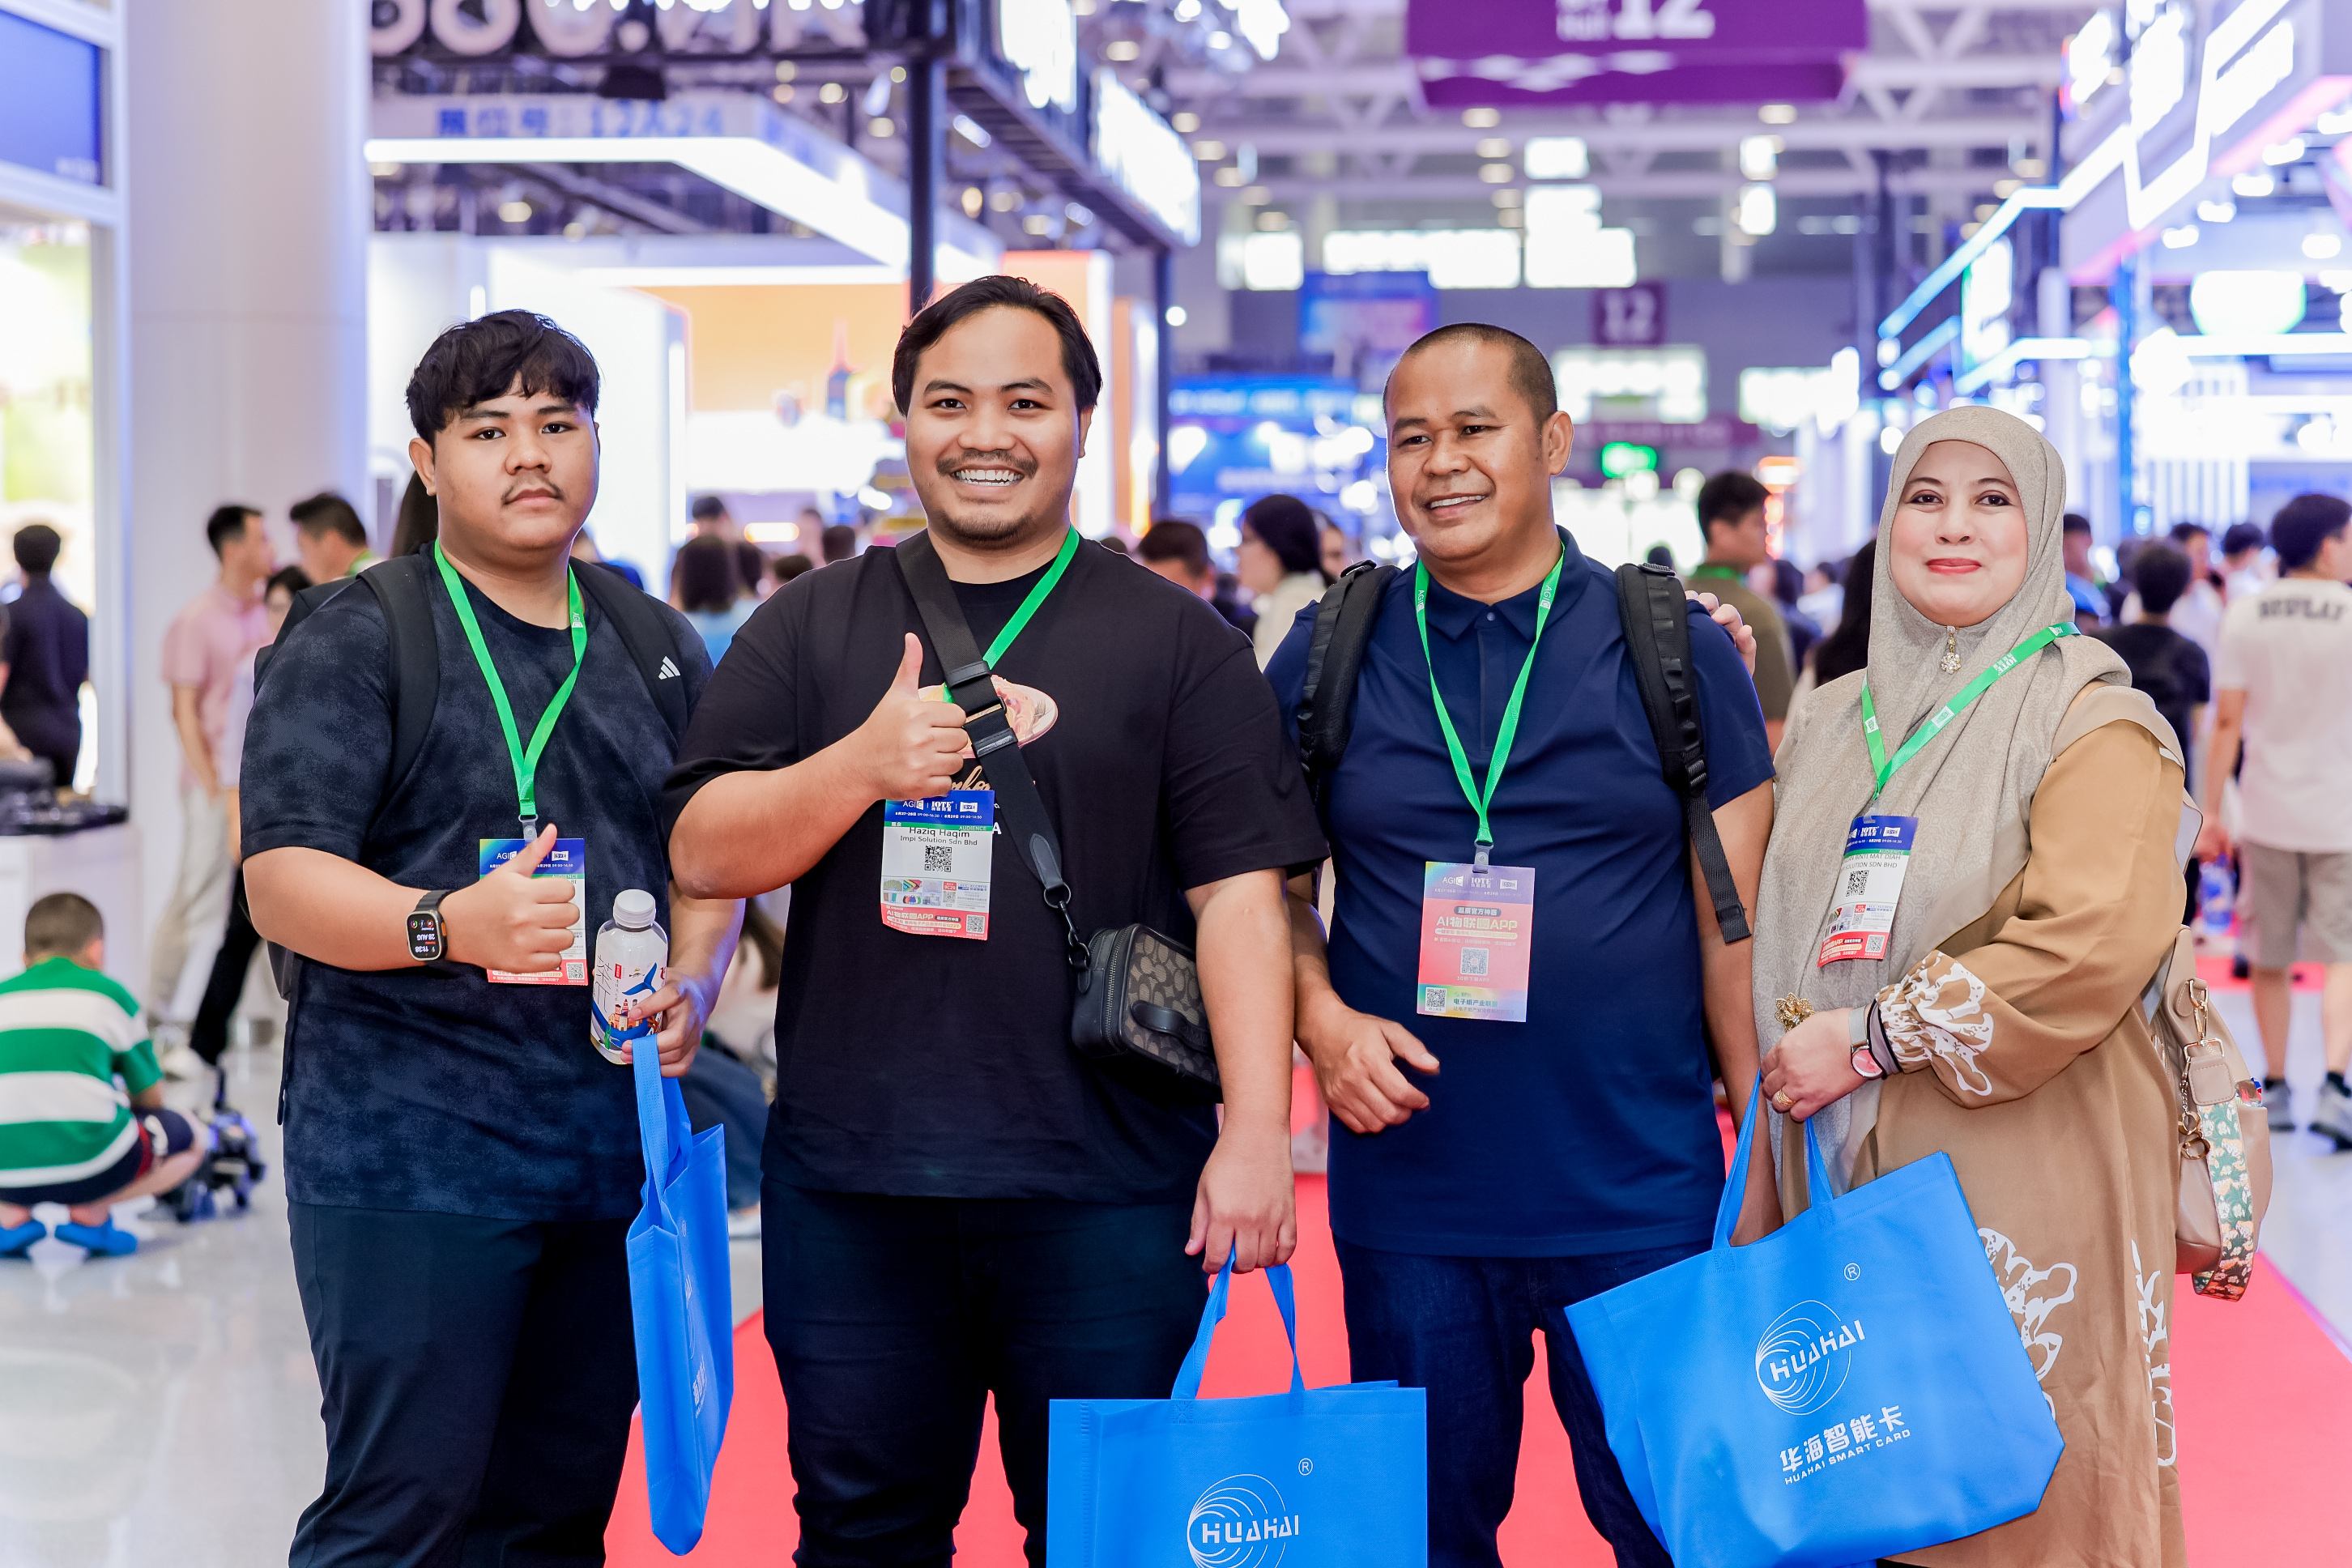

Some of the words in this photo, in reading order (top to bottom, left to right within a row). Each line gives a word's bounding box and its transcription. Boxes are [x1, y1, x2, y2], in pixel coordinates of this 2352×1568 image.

[909, 826, 935, 837] Haziq
[939, 829, 970, 838] Haqim
[918, 836, 947, 844] Solution
[1769, 1319, 1866, 1382] HUAHAI
[1779, 1404, 1905, 1472] 华海智能卡
[1784, 1460, 1826, 1485] HUAHAI
[1828, 1443, 1872, 1465] SMART
[1875, 1429, 1911, 1447] CARD
[1202, 1515, 1299, 1544] HUAHAI
